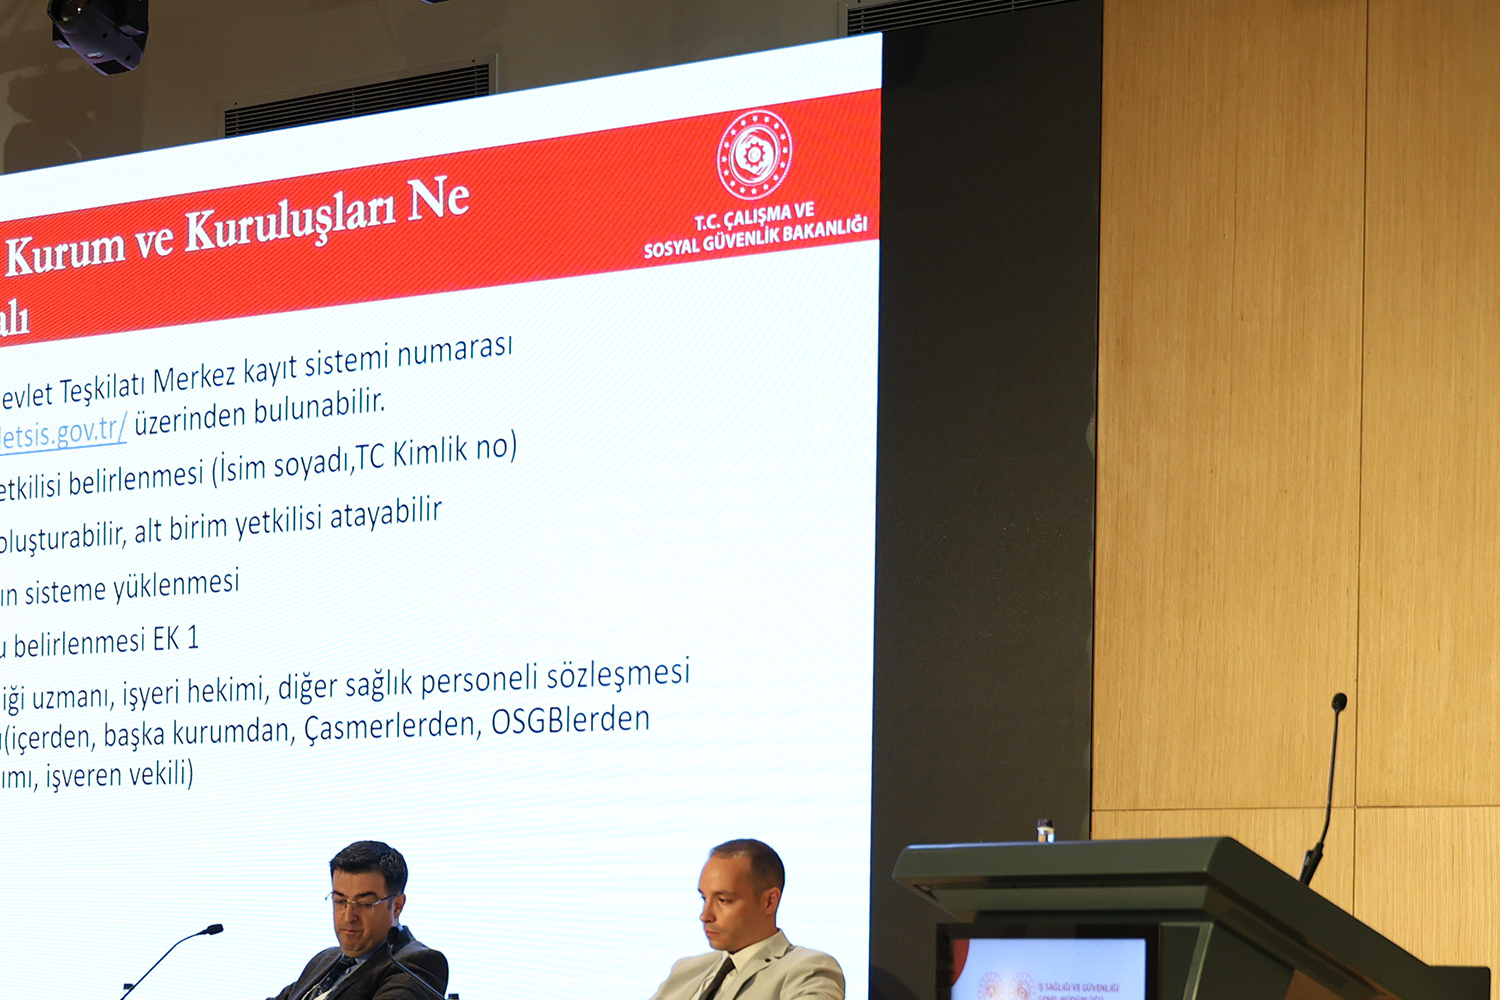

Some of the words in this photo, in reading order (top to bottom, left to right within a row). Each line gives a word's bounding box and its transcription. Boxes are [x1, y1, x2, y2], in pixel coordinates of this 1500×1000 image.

[5, 236, 125, 277] Kurum
[135, 229, 173, 258] ve
[185, 191, 396, 251] Kuruluşları
[407, 175, 469, 220] Ne
[645, 238, 700, 258] SOSYAL
[703, 225, 779, 250] GÜVENLİK
[783, 214, 867, 241] BAKANLIĞI
[695, 214, 720, 230] T.C.
[724, 205, 791, 231] ÇALIŞMA
[795, 201, 814, 217] VE
[60, 373, 144, 407] Teşkilatı
[154, 363, 235, 393] Merkez
[245, 356, 297, 387] kayıt
[306, 342, 388, 376] sistemi
[399, 336, 511, 366] numarası
[136, 403, 245, 436] üzerinden
[255, 388, 384, 423] bulunabilir.
[70, 459, 203, 495] belirlenmesi
[212, 452, 265, 488] (İsim
[275, 443, 384, 481] soyadı,TC
[394, 435, 467, 467] Kimlik
[478, 429, 516, 463] no)
[135, 517, 162, 543] alt
[171, 513, 226, 540] birim
[236, 504, 321, 542] yetkilisi
[331, 495, 442, 532] atayabilir
[26, 580, 105, 605] sisteme
[114, 566, 238, 605] yüklenmesi
[15, 627, 144, 658] belirlenmesi
[154, 626, 179, 650] EK
[189, 625, 198, 649] 1
[33, 689, 114, 711] uzmanı,
[124, 679, 178, 711] işyeri
[188, 675, 269, 705] hekimi,
[279, 672, 338, 705] diğer
[346, 668, 412, 702] sağlık
[422, 663, 537, 700] personeli
[548, 656, 689, 693] sözleşmesi
[105, 721, 164, 752] başka
[174, 717, 295, 746] kurumdan,
[305, 710, 481, 747] Çasmerlerden,
[492, 704, 649, 734] OSGBlerden
[47, 763, 121, 793] işveren
[130, 758, 193, 790] vekili)
